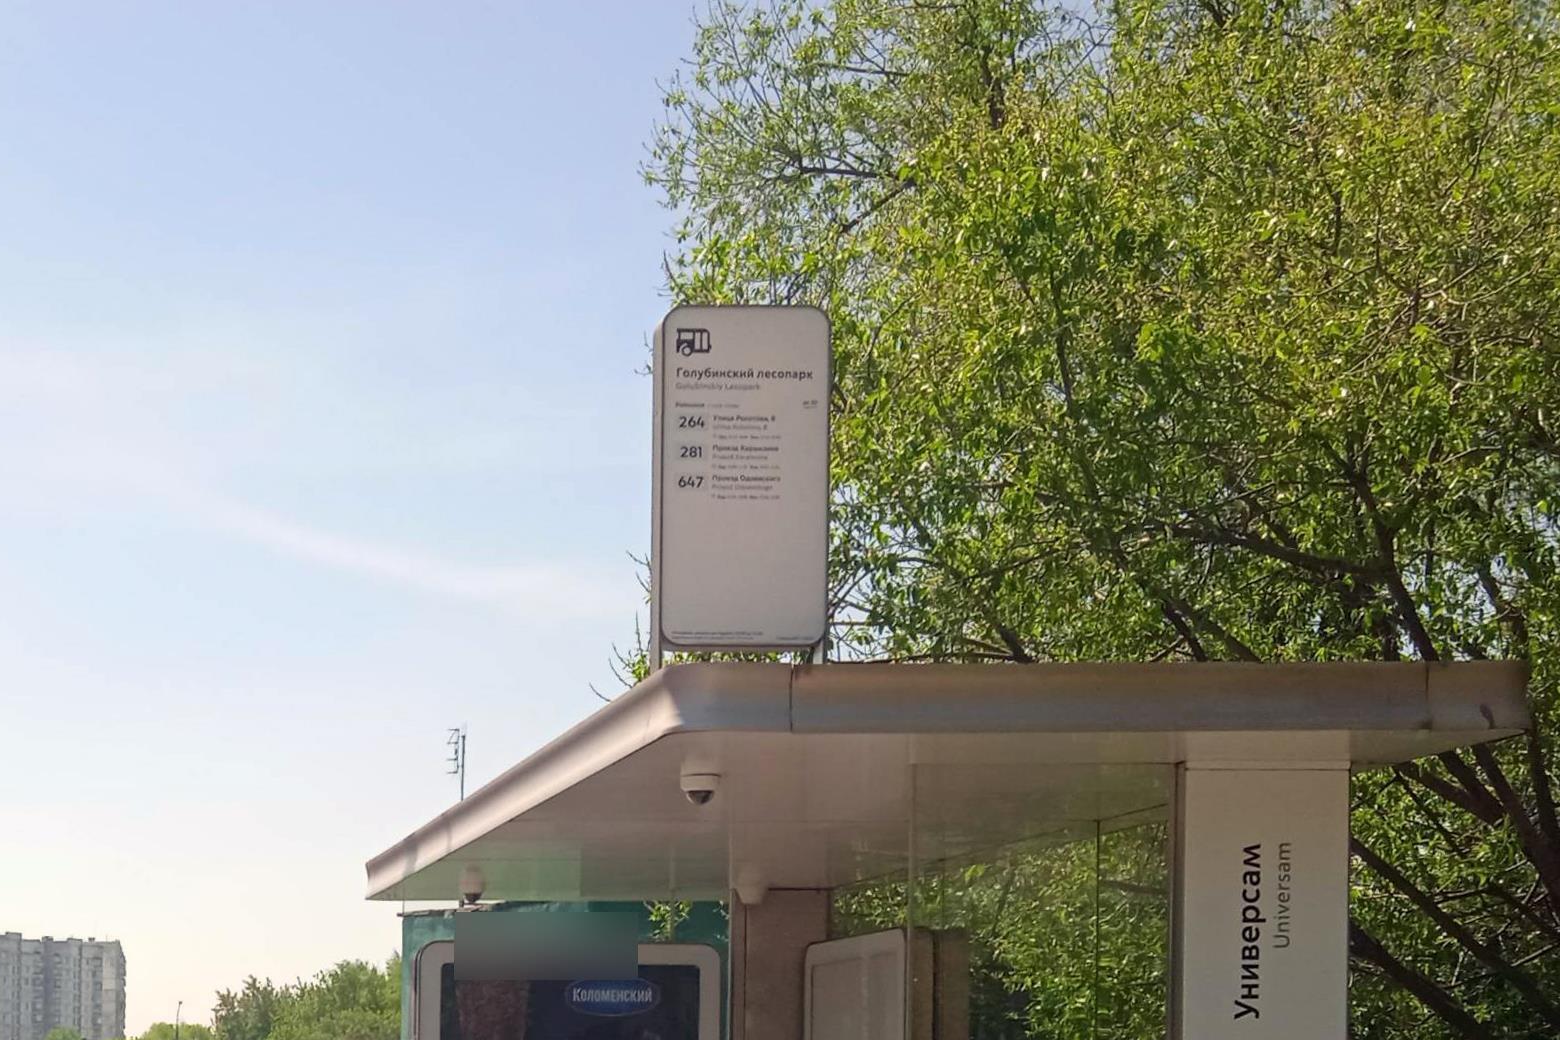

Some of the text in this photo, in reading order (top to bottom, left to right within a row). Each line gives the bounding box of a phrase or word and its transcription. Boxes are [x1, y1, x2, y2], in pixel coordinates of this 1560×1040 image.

[676, 367, 814, 382] Голубинский лесопарк
[679, 416, 705, 429] 264
[680, 446, 703, 458] 281
[678, 476, 704, 489] 647
[1272, 842, 1292, 949] Universam
[1233, 843, 1267, 1020] Универсам
